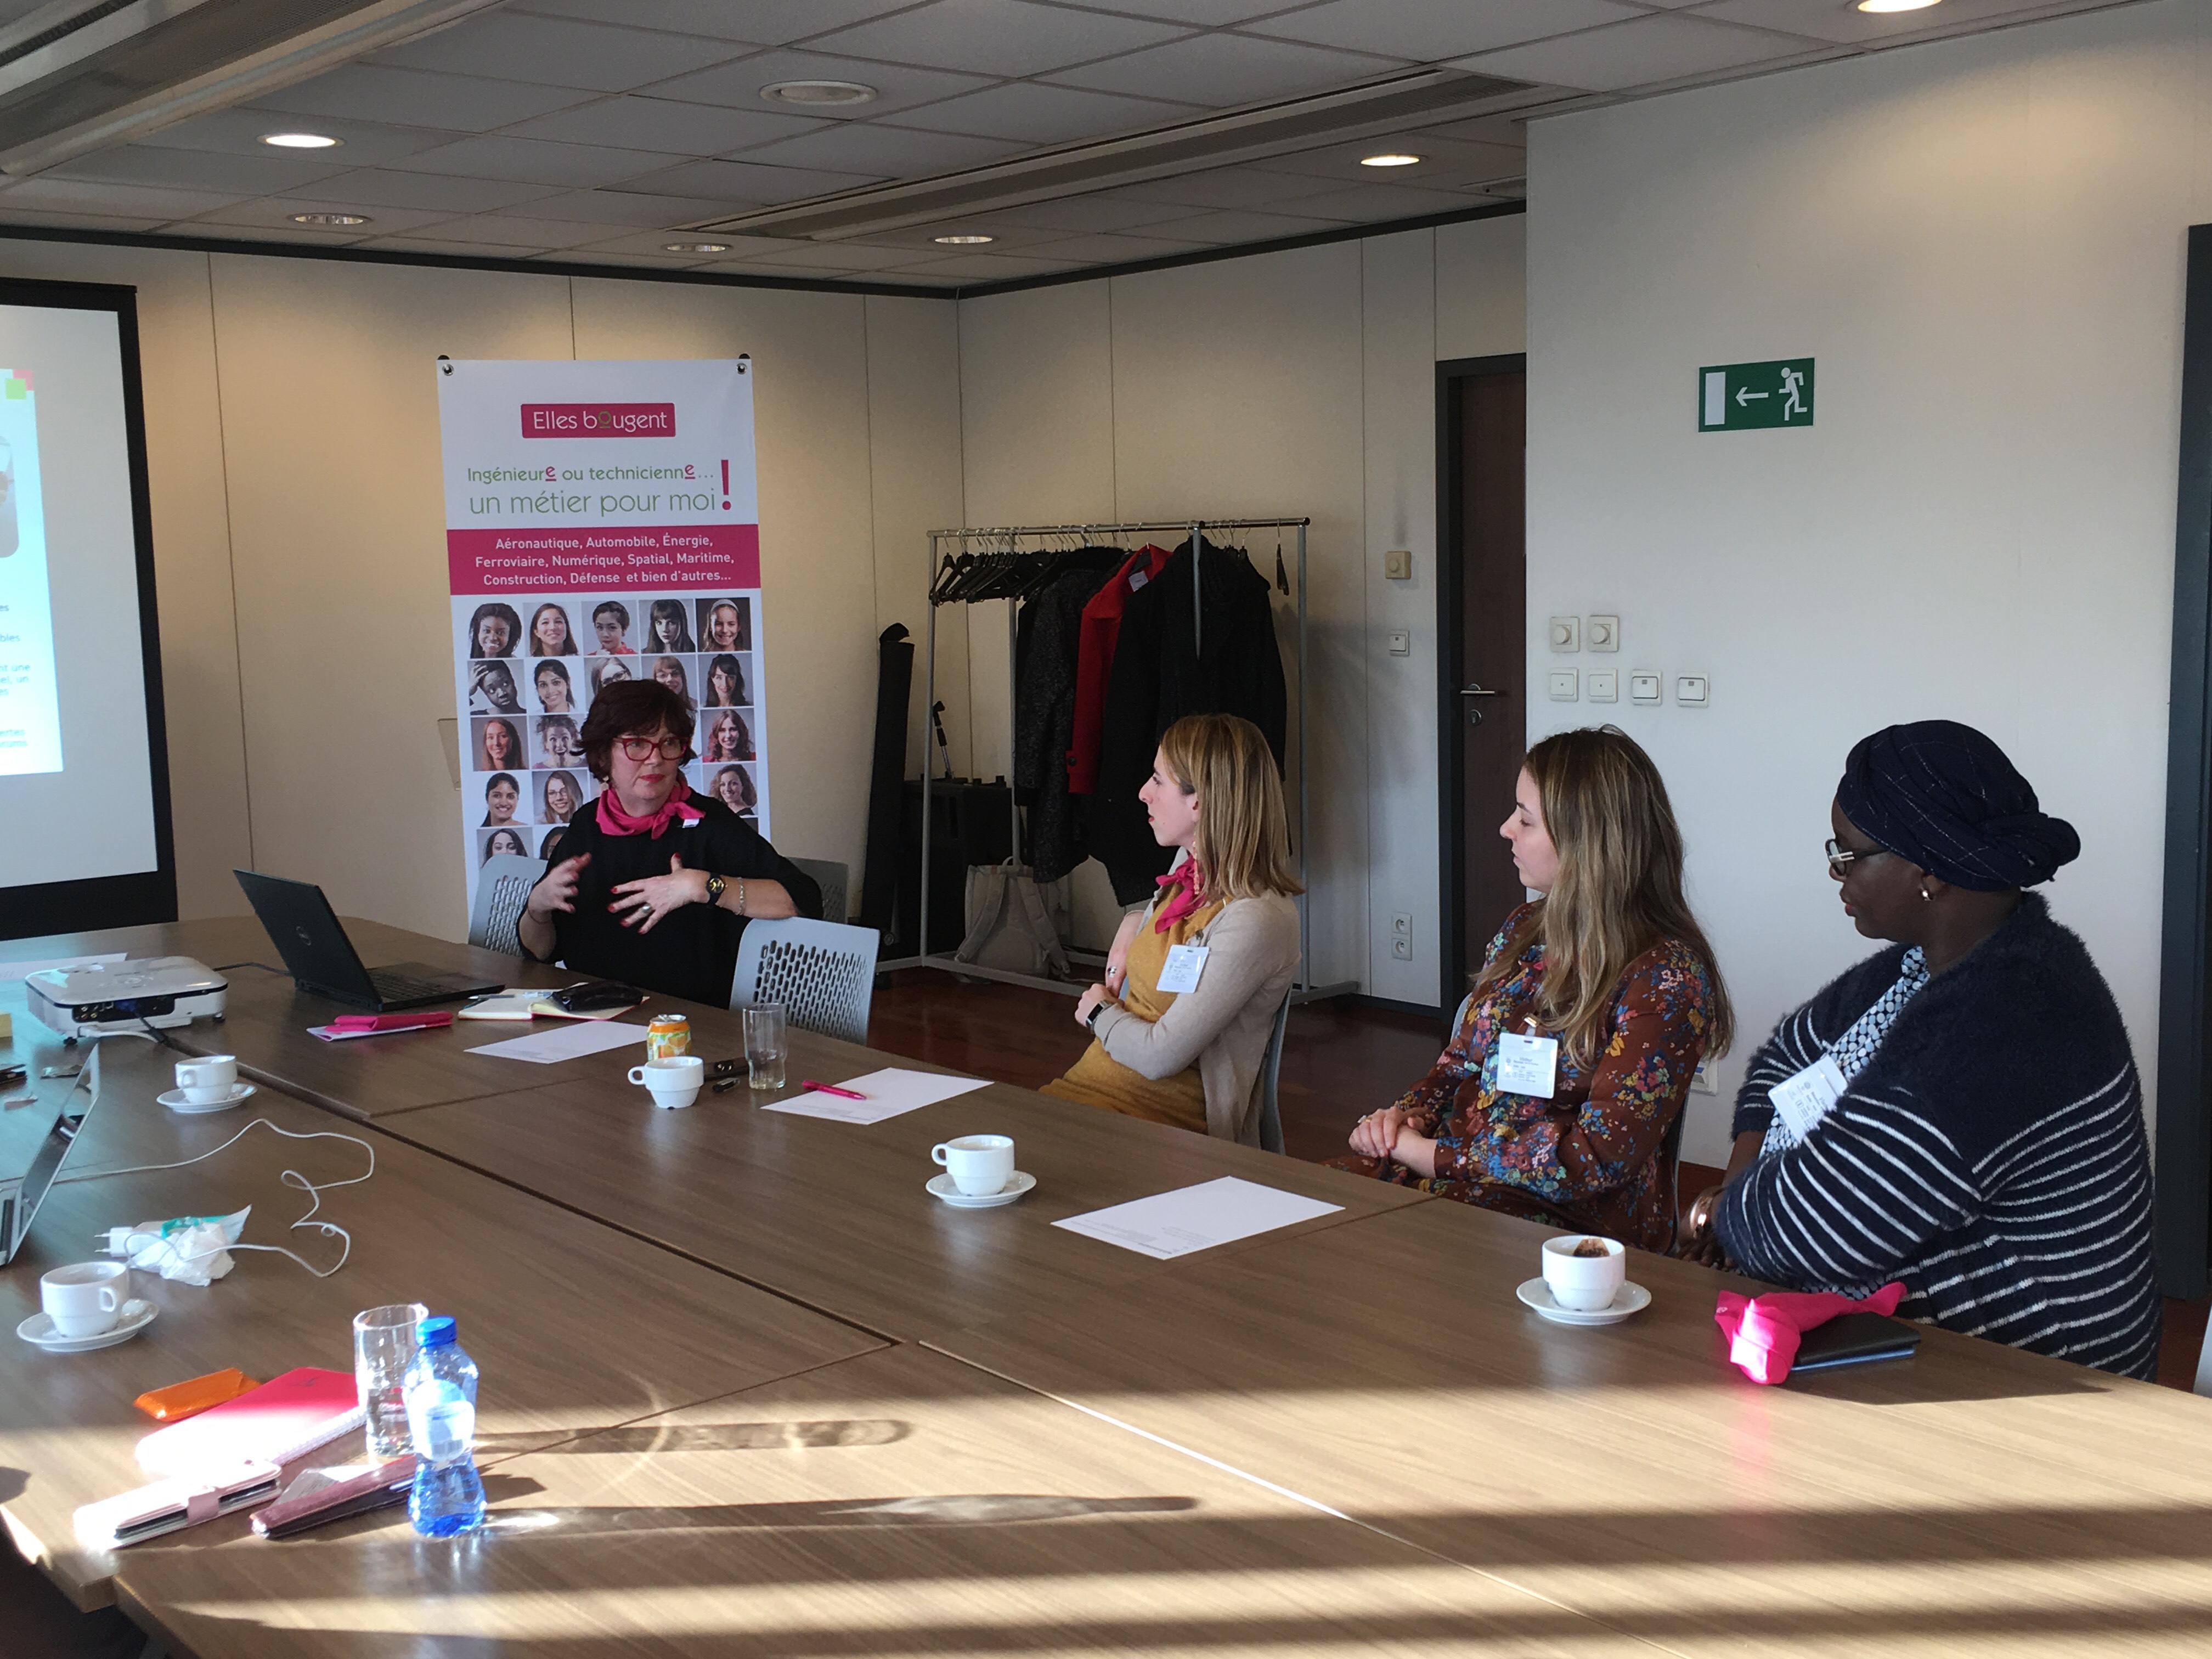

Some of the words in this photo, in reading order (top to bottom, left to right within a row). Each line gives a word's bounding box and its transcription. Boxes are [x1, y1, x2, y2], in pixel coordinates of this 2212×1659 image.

[533, 410, 578, 430] Elles
[583, 410, 668, 433] bougent
[467, 466, 557, 485] Ingénieure
[562, 470, 584, 481] ou
[470, 496, 501, 515] un
[510, 490, 592, 514] métier
[600, 494, 661, 517] pour
[495, 537, 583, 551] Aéronautique,
[585, 536, 659, 549] Automobile,
[663, 532, 713, 549] Énergie,
[476, 556, 549, 568] Ferroviaire,
[552, 554, 624, 568] Numérique,
[628, 553, 673, 567] Spatial,
[677, 552, 735, 565] Maritime,
[483, 573, 567, 586] Construction,
[570, 572, 620, 584] Défense
[626, 572, 639, 583] et
[641, 571, 667, 582] bien
